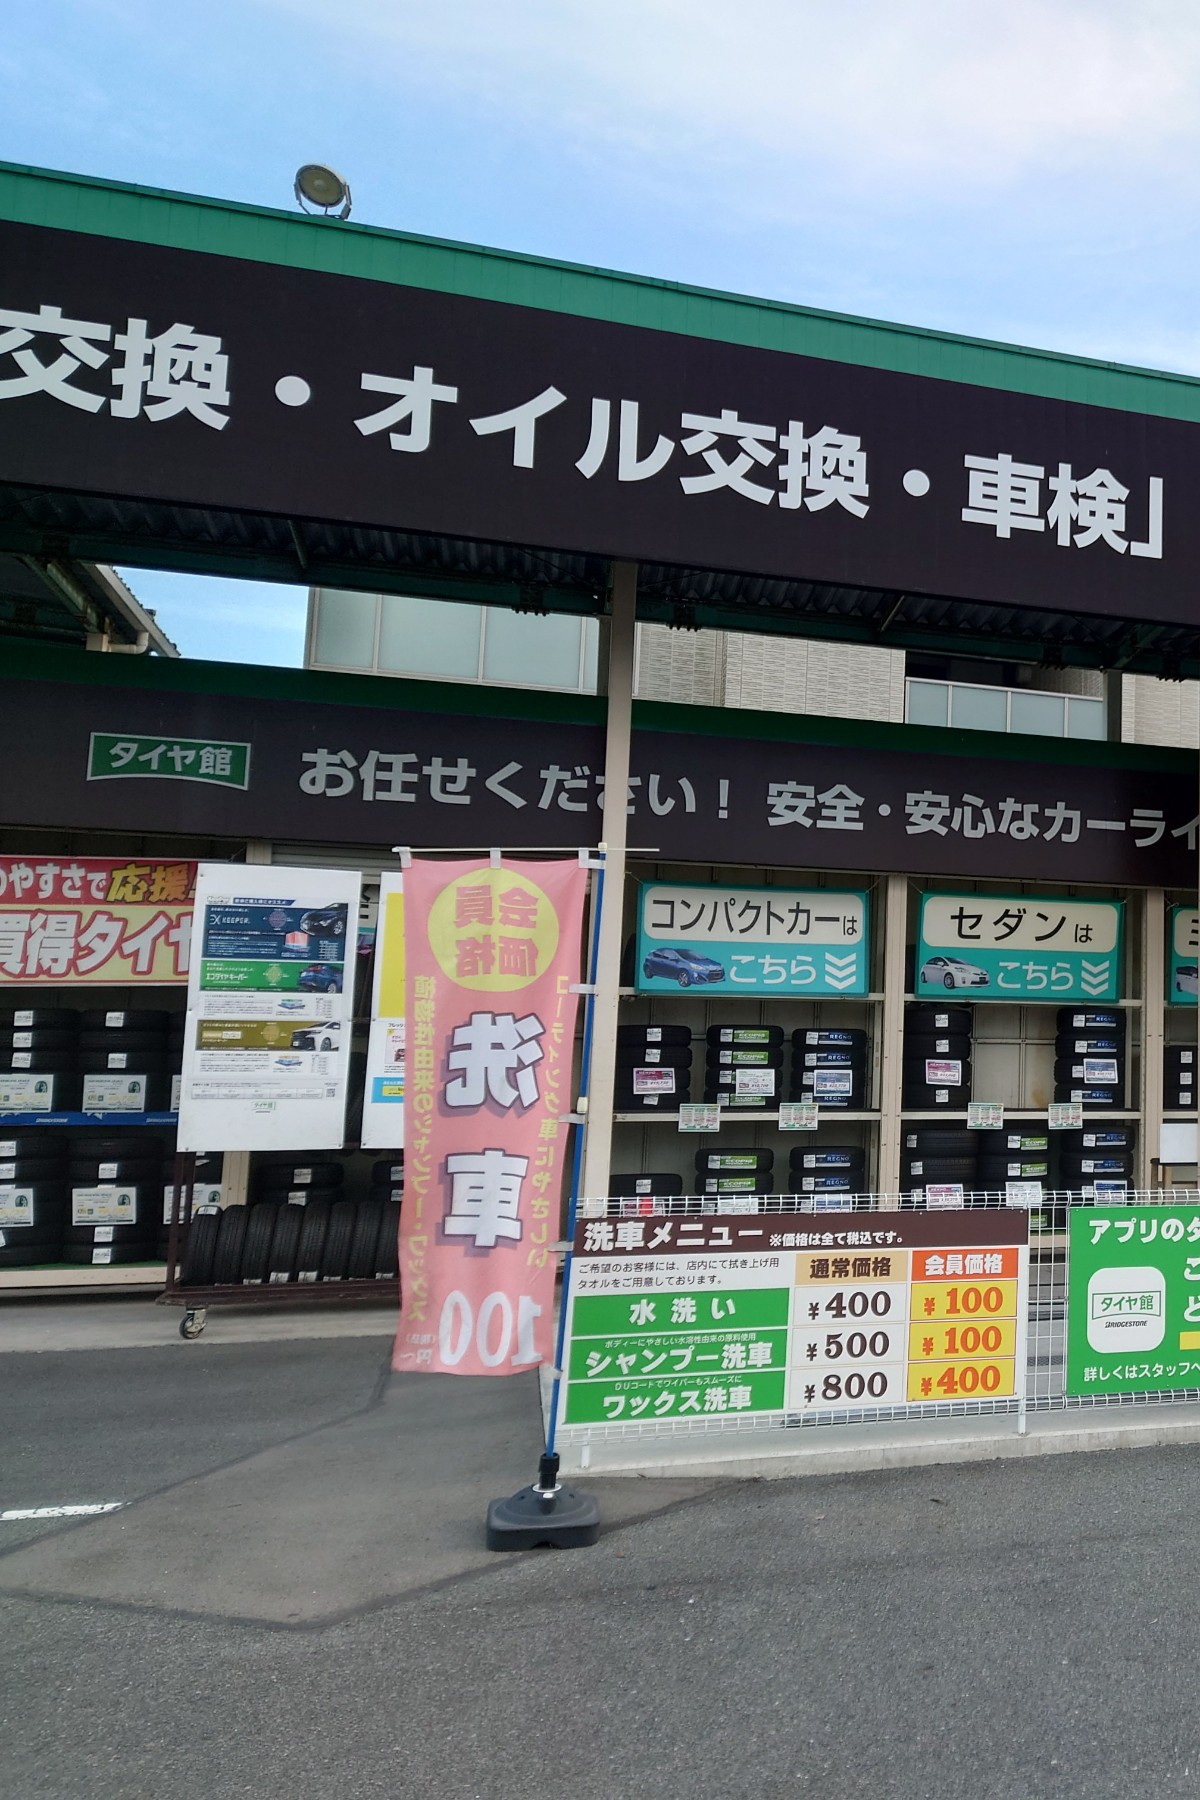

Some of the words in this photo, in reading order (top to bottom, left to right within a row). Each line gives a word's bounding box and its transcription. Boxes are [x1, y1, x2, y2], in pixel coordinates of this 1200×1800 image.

[109, 741, 232, 777] タイヤ館
[0, 862, 197, 903] やすさで応援
[651, 898, 858, 937] コンパクトカーは
[950, 906, 1093, 944] セダンは
[730, 955, 817, 986] こちら
[997, 961, 1074, 991] こちら
[583, 1222, 763, 1252] 洗車メニュー
[810, 1257, 892, 1278] 通常価格
[924, 1252, 1003, 1276] 会員価格
[629, 1297, 736, 1326] 水洗い
[1101, 1295, 1154, 1312] タイヤ館
[585, 1341, 772, 1378] シャンプー洗車
[603, 1385, 752, 1419] ワックス洗車
